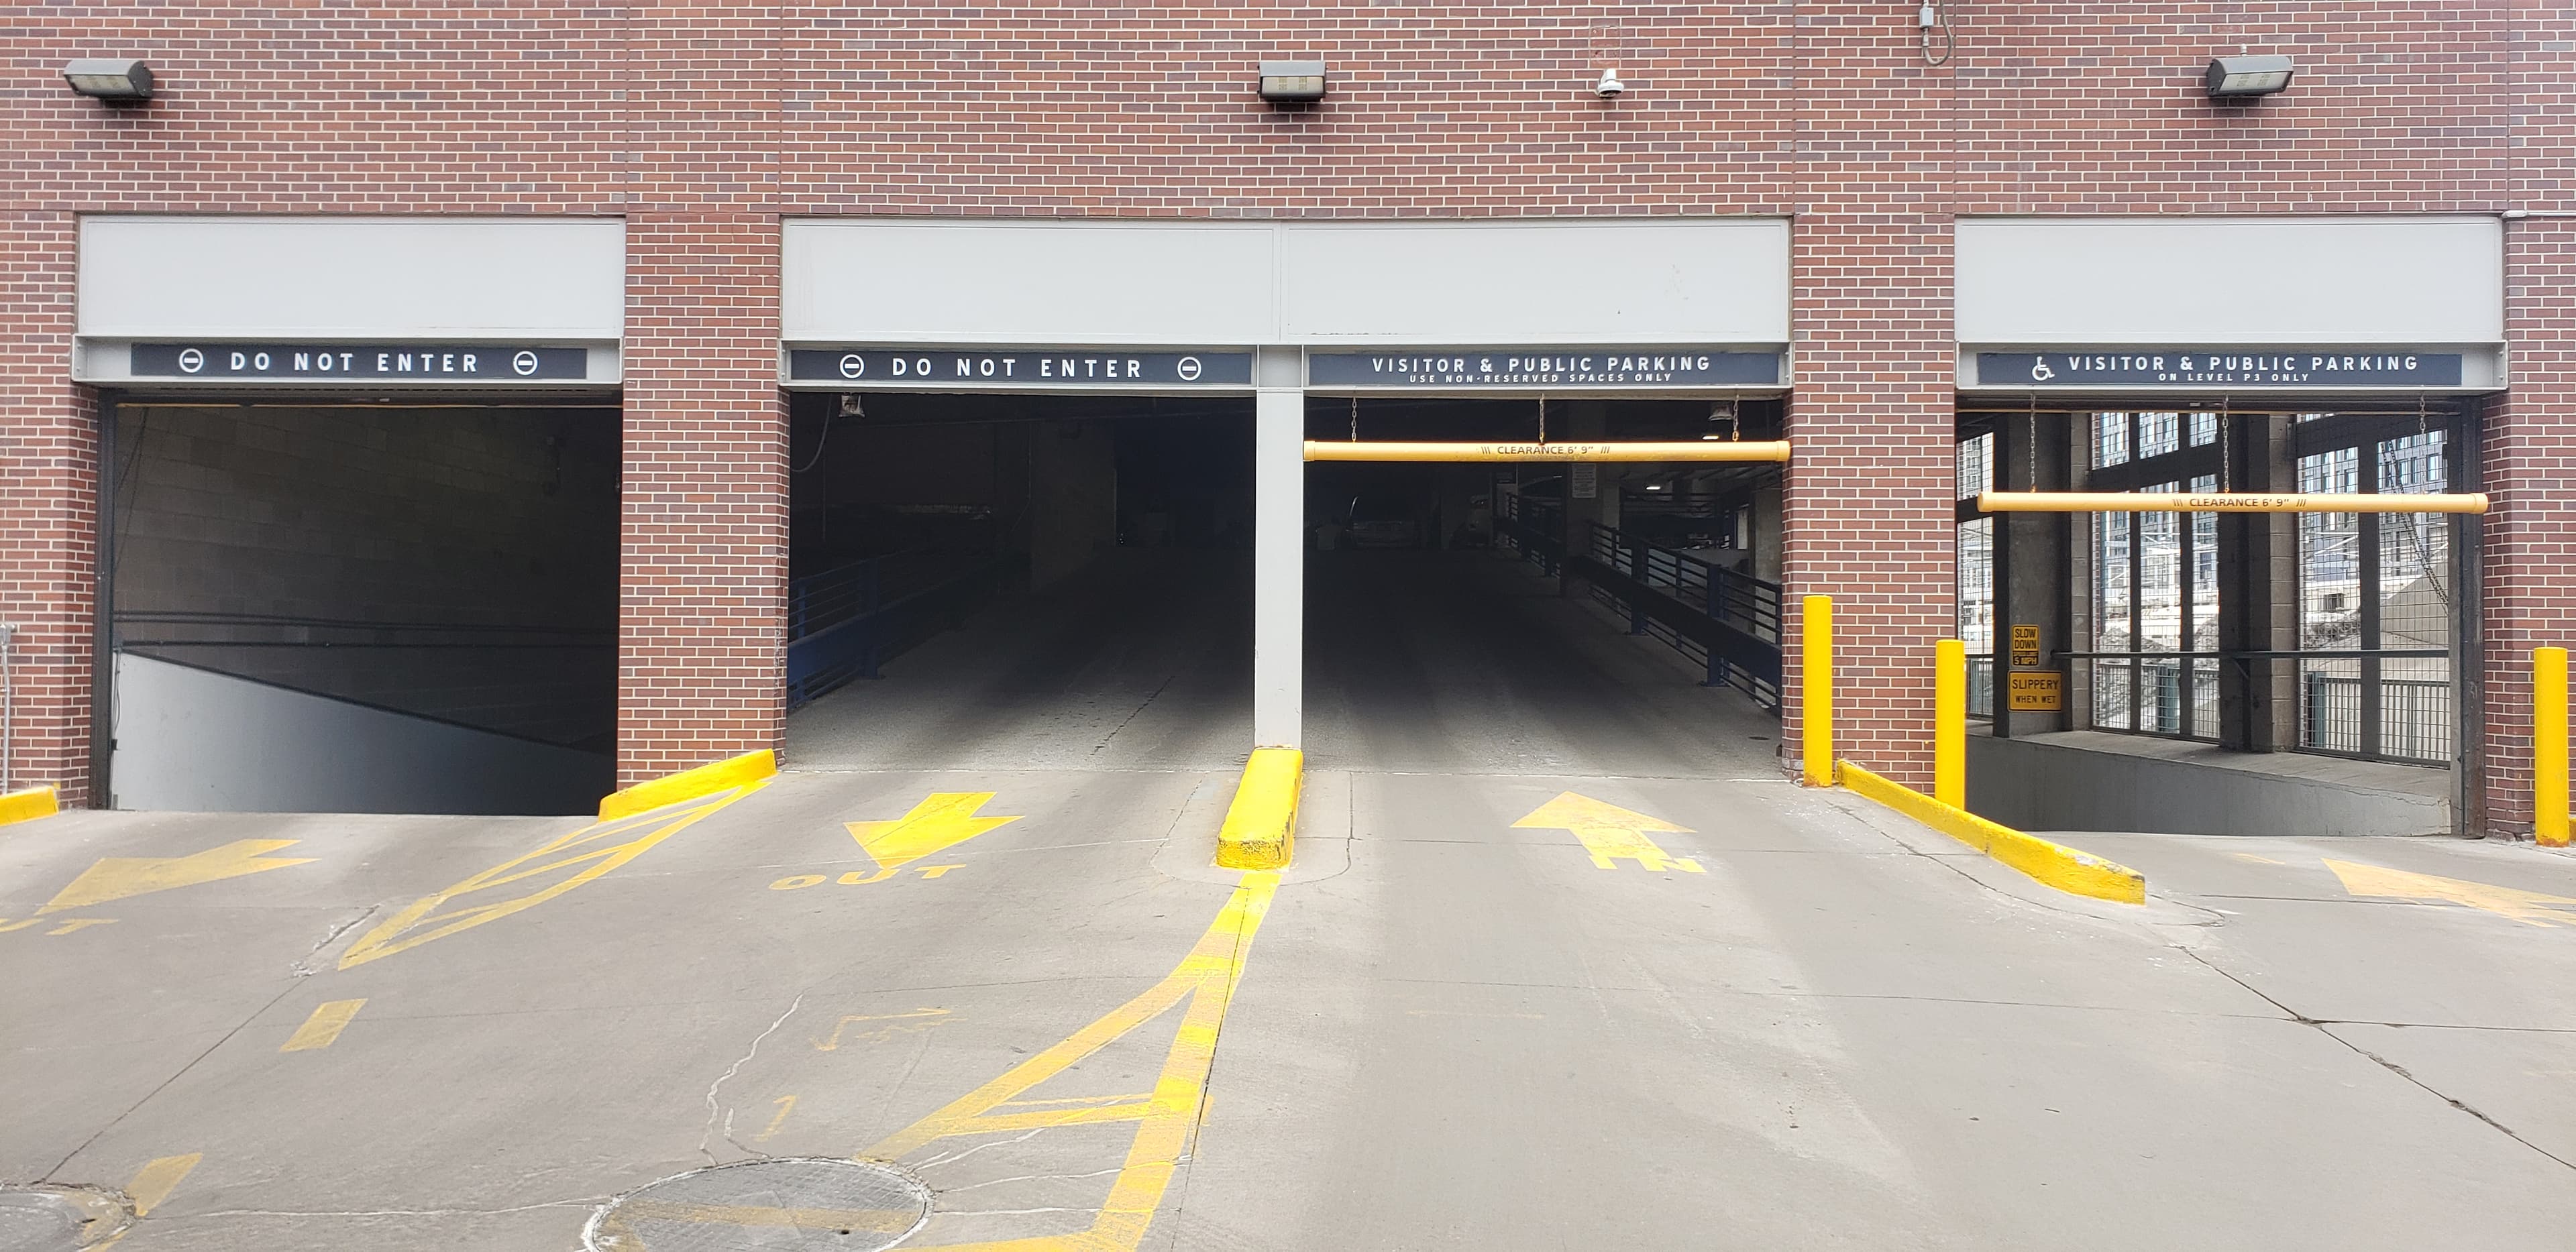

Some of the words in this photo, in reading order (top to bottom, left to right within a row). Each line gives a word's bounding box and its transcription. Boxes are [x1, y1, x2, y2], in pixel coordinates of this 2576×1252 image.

[230, 352, 270, 371] DO
[294, 353, 353, 371] NOT
[377, 353, 476, 372] ENTER
[1373, 358, 1464, 372] VISITOR
[1480, 358, 1493, 372] &
[1509, 357, 1591, 372] PUBLIC
[1607, 356, 1709, 372] PARKING
[2068, 356, 2164, 371] VISITOR
[2180, 356, 2194, 371] &
[2210, 357, 2295, 371] PUBLIC
[2312, 356, 2417, 371] PARKING
[892, 358, 931, 376] DO
[957, 358, 1016, 377] NOT
[1041, 359, 1140, 378] ENTER
[1409, 375, 1435, 383] USE
[1446, 374, 1558, 383] NON-RESERVED
[1569, 374, 1624, 382] SPACES
[1634, 373, 1671, 382] ONLY
[2158, 373, 2177, 382] ON
[2187, 373, 2233, 382] LEVEL
[2244, 373, 2260, 382] P3
[2271, 374, 2308, 382] ONLY
[1497, 446, 1564, 455] CLEARANCE
[2189, 498, 2259, 507] CLEARANCE
[2015, 628, 2037, 638] SLOW
[2015, 640, 2037, 649] DOWN
[2012, 679, 2059, 689] SLIPPERY
[2015, 695, 2037, 703] WHEN
[2041, 695, 2056, 703] WET
[768, 864, 967, 891] OUT
